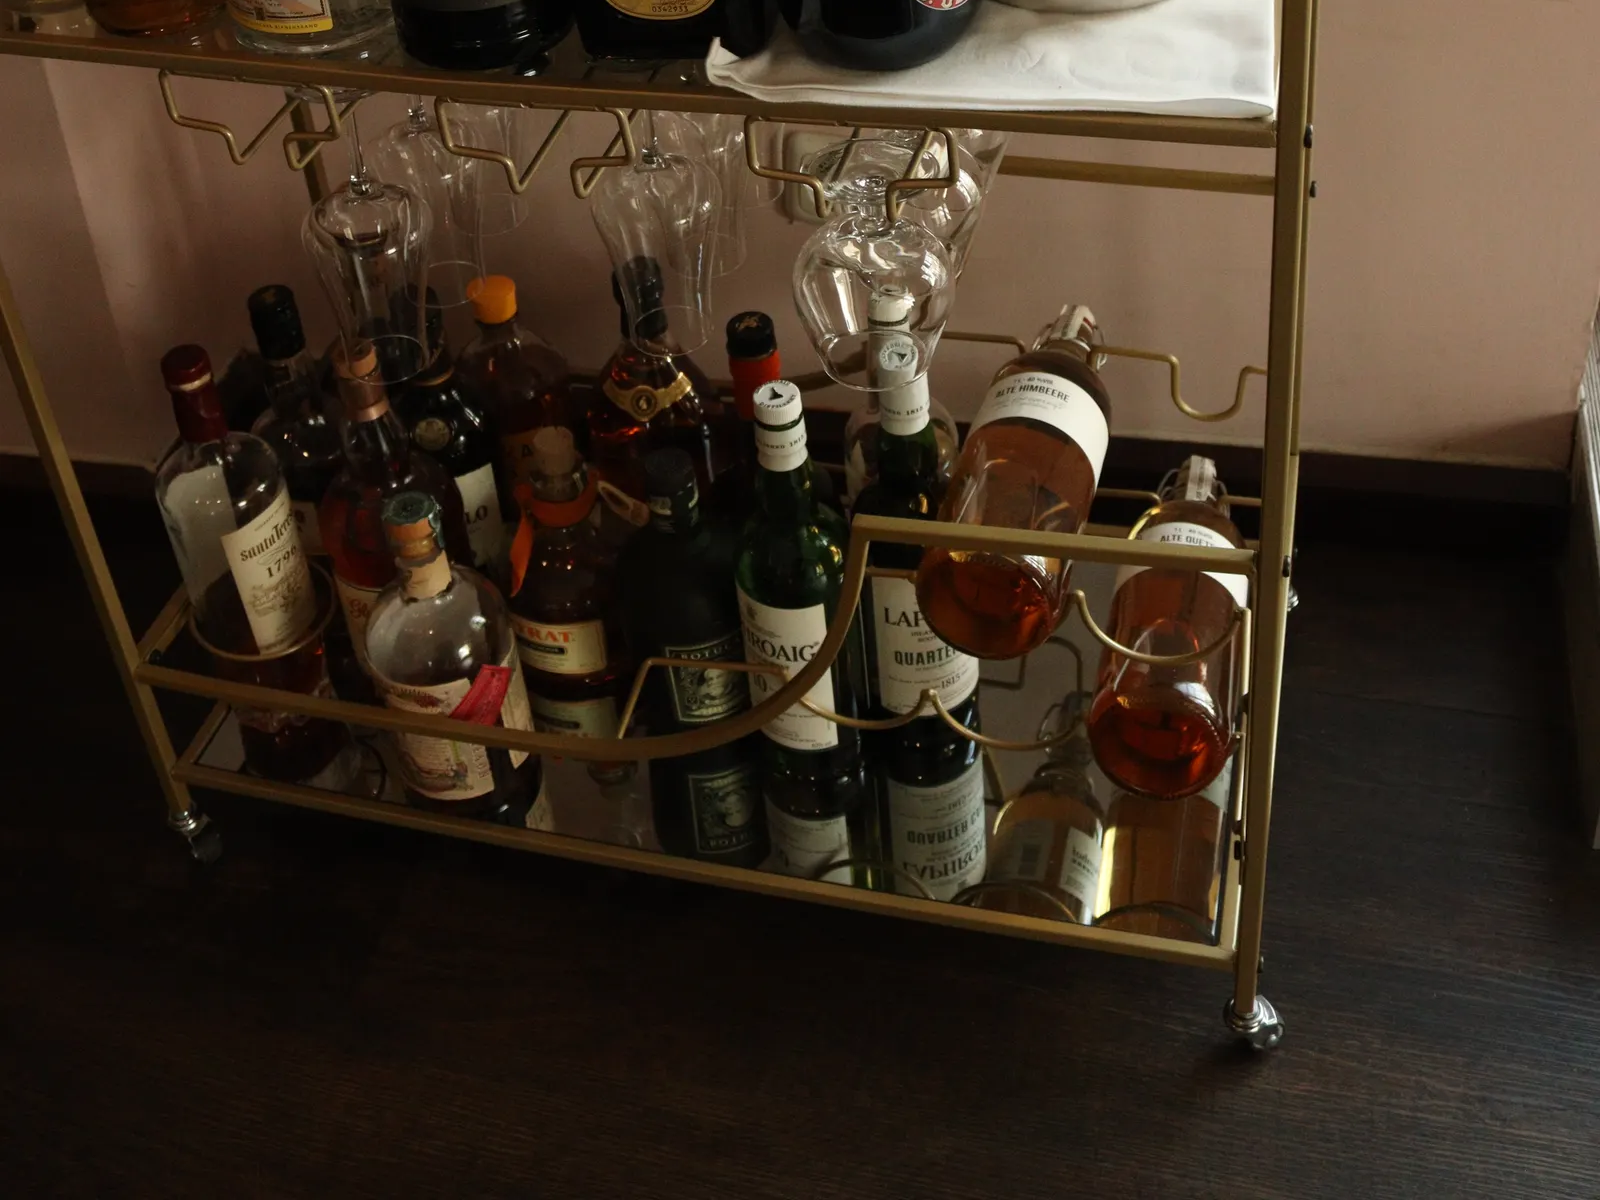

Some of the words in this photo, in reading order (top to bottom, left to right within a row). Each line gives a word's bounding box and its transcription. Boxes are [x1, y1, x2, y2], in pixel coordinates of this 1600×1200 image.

[1019, 384, 1070, 403] HIMBEERE
[267, 544, 297, 578] 1796
[884, 606, 927, 628] LAP
[941, 674, 960, 689] 1815
